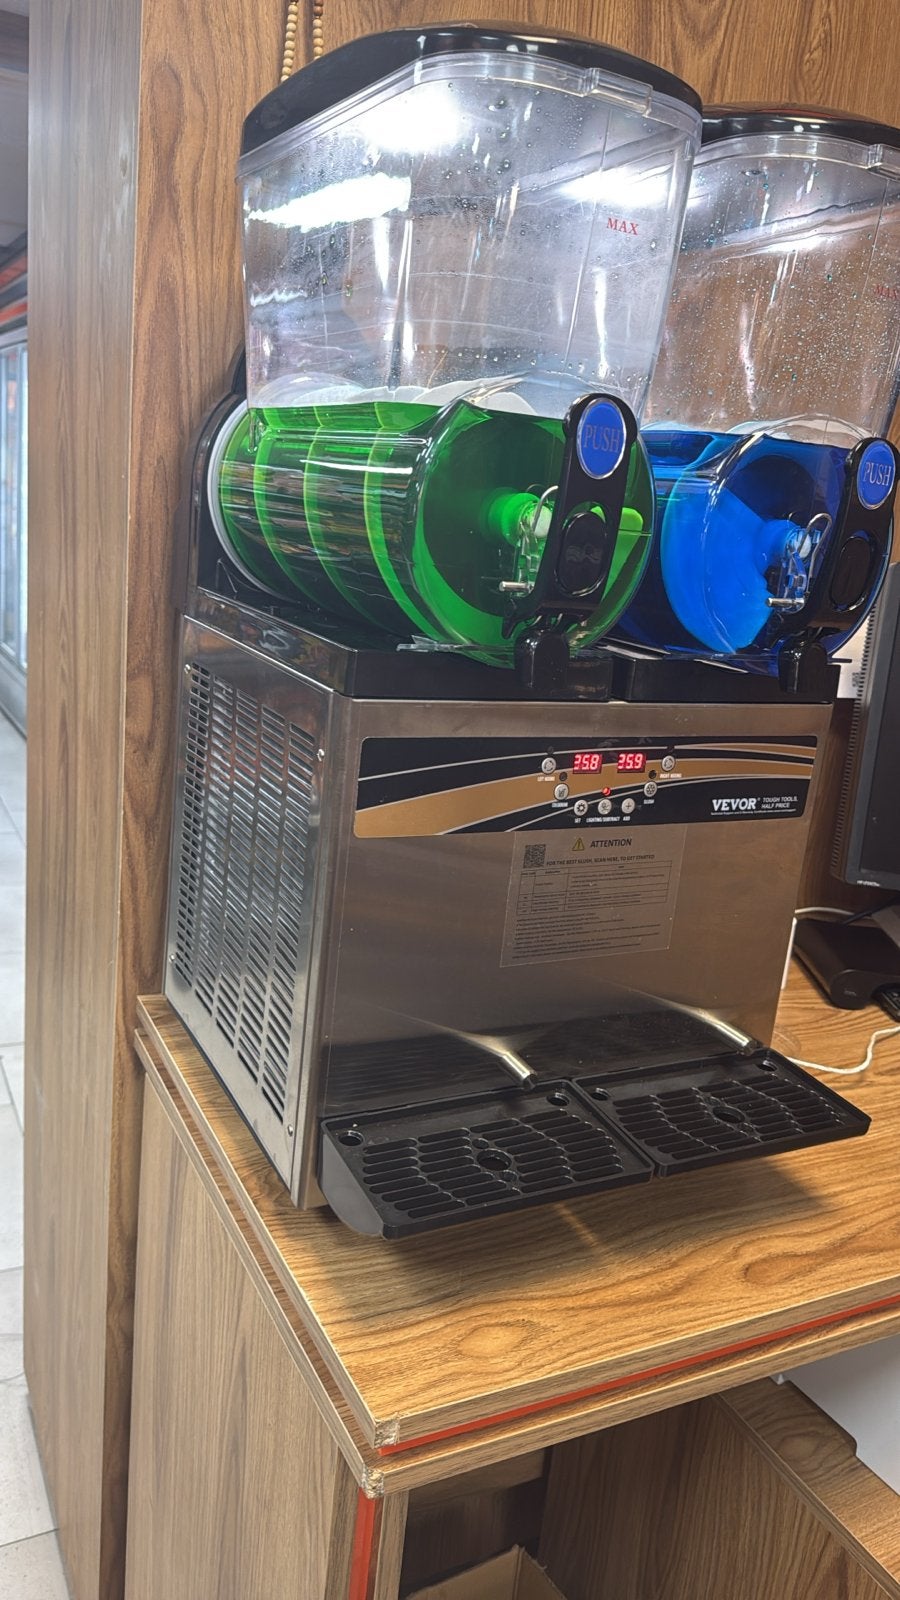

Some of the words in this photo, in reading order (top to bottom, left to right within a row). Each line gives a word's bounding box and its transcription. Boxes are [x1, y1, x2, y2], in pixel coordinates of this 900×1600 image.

[606, 217, 639, 236] MAX
[873, 284, 898, 299] MAX
[583, 424, 621, 453] PUSH
[862, 461, 892, 486] PUSH
[712, 798, 757, 811] VEVOR
[590, 838, 632, 848] ATTENTION
